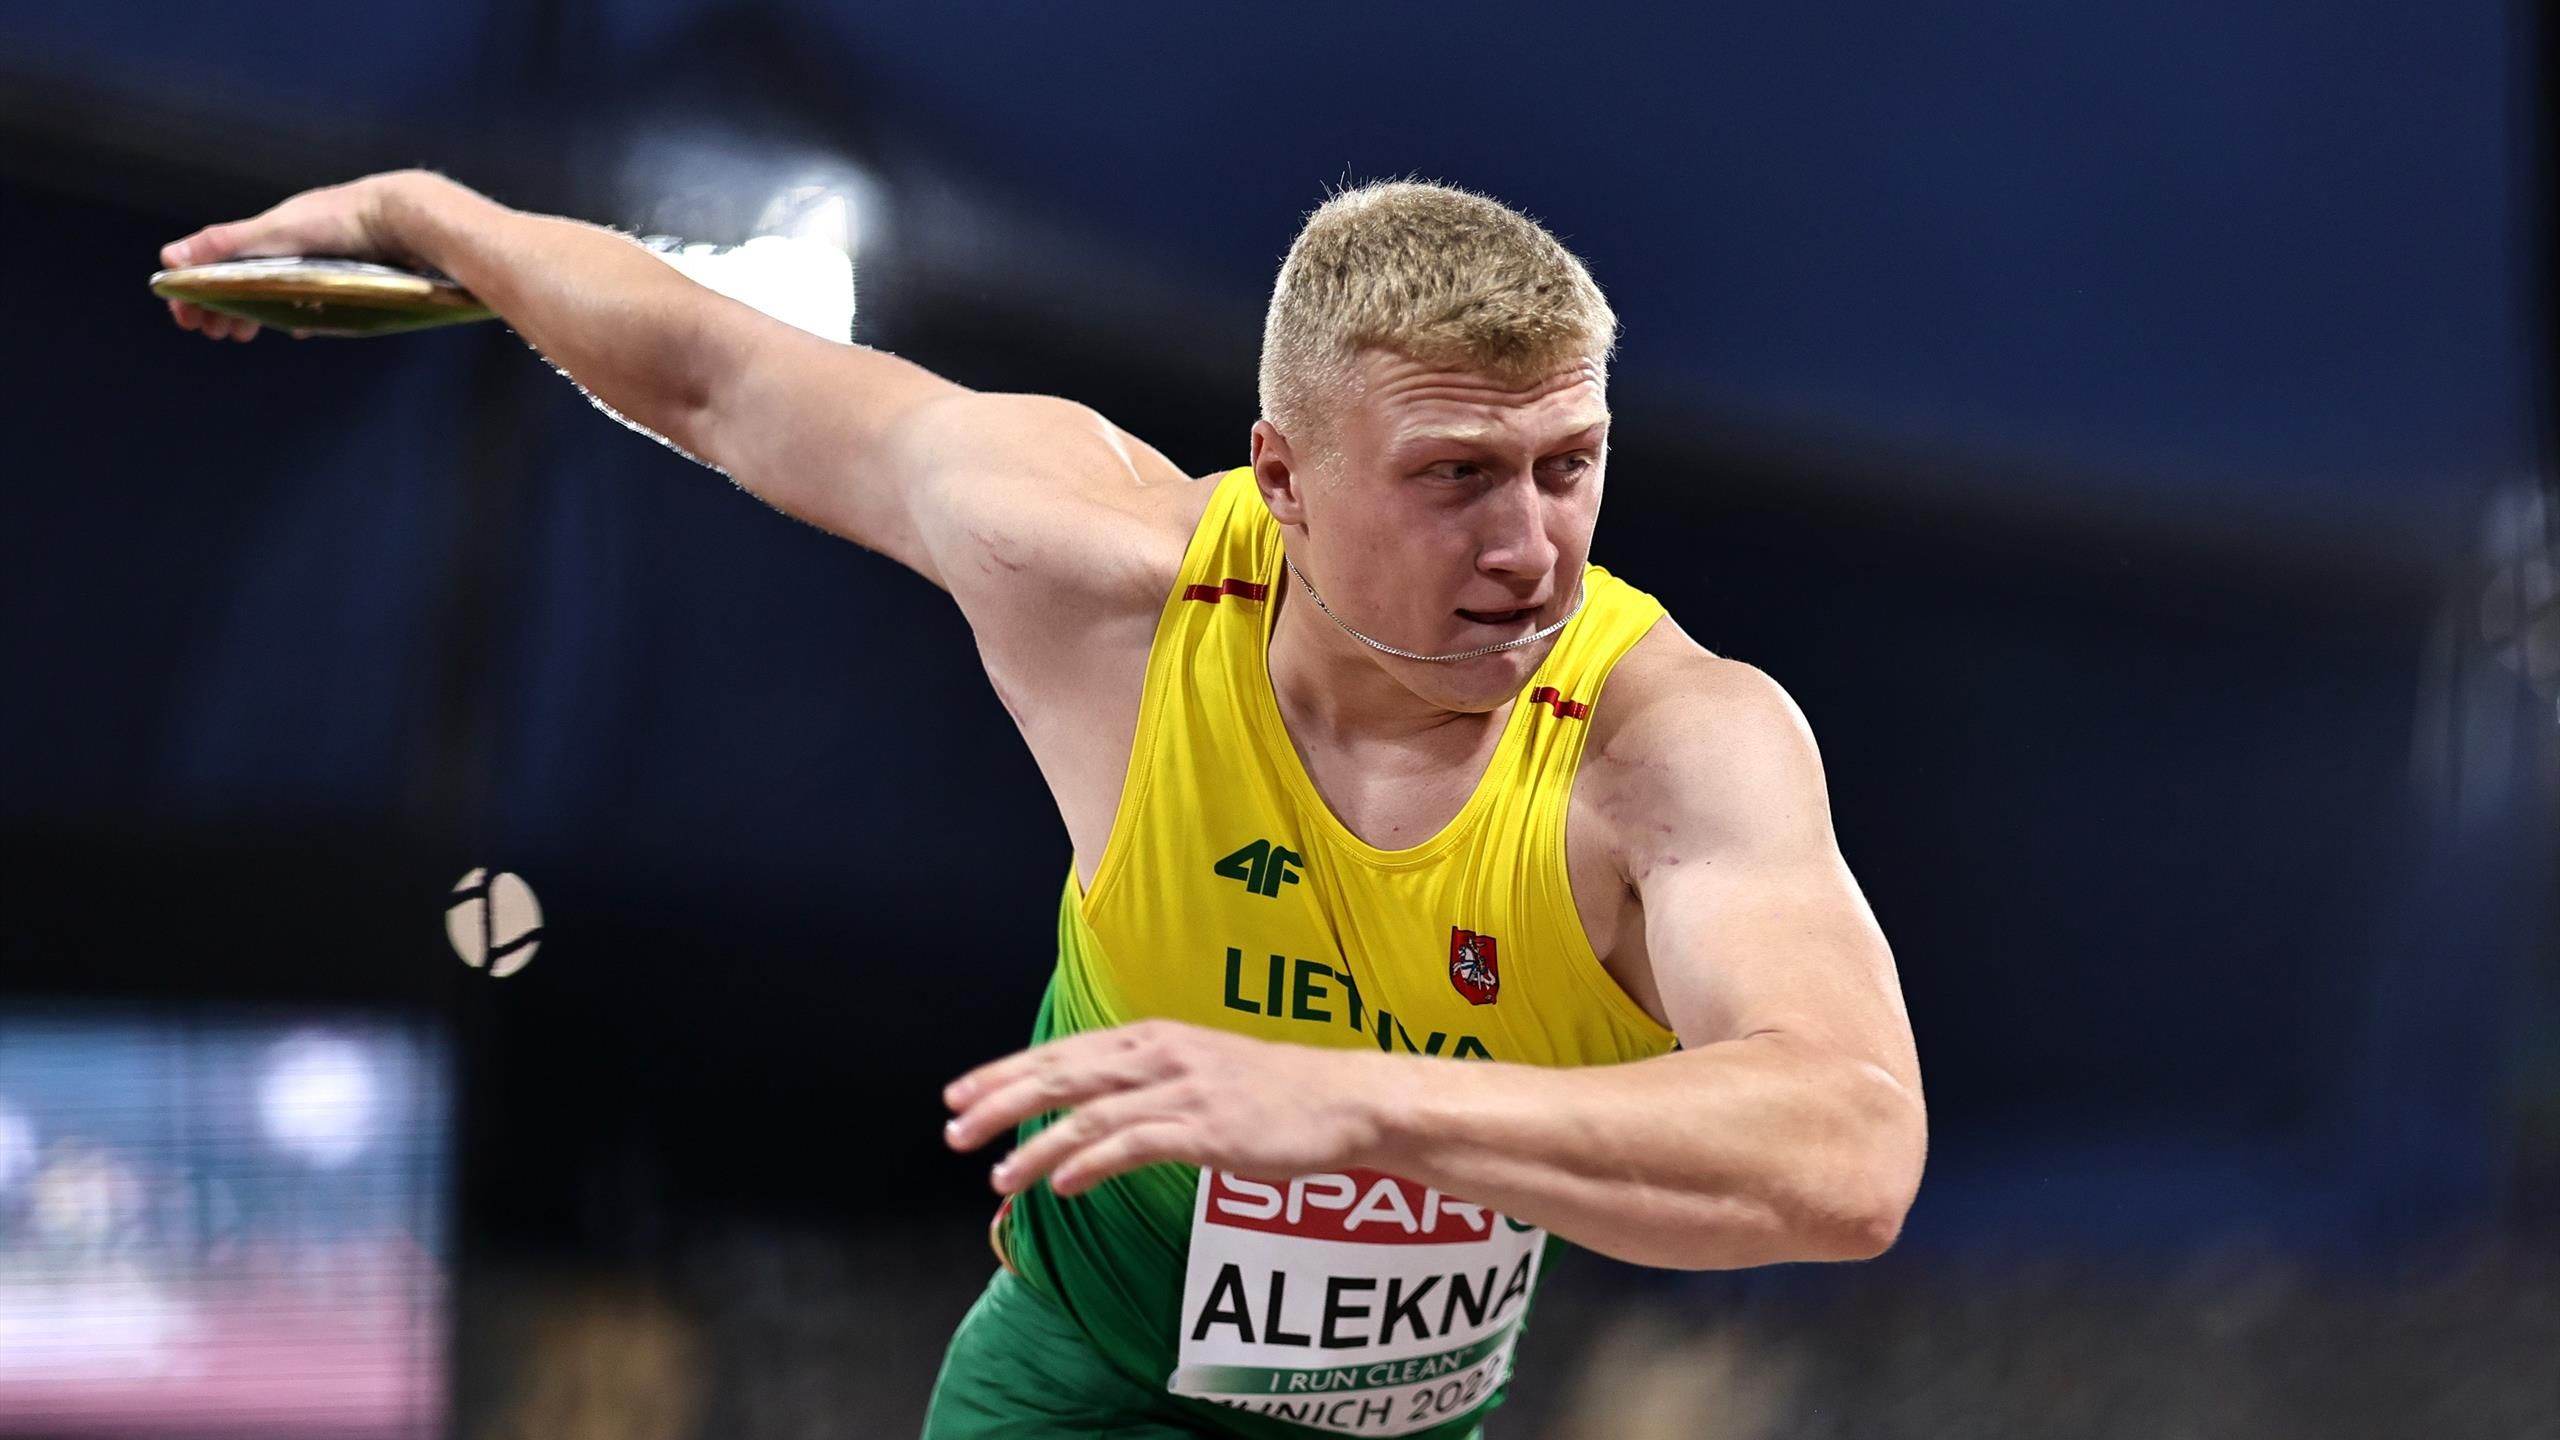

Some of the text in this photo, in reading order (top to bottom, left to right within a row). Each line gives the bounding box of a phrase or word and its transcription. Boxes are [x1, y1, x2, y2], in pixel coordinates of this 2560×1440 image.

[1214, 839, 1304, 898] 4F
[1217, 1172, 1486, 1233] SPAR
[1191, 1252, 1533, 1348] ALEKNA
[1270, 1373, 1281, 1392] I
[1288, 1368, 1358, 1392] RUN
[1222, 1397, 1394, 1429] NICH
